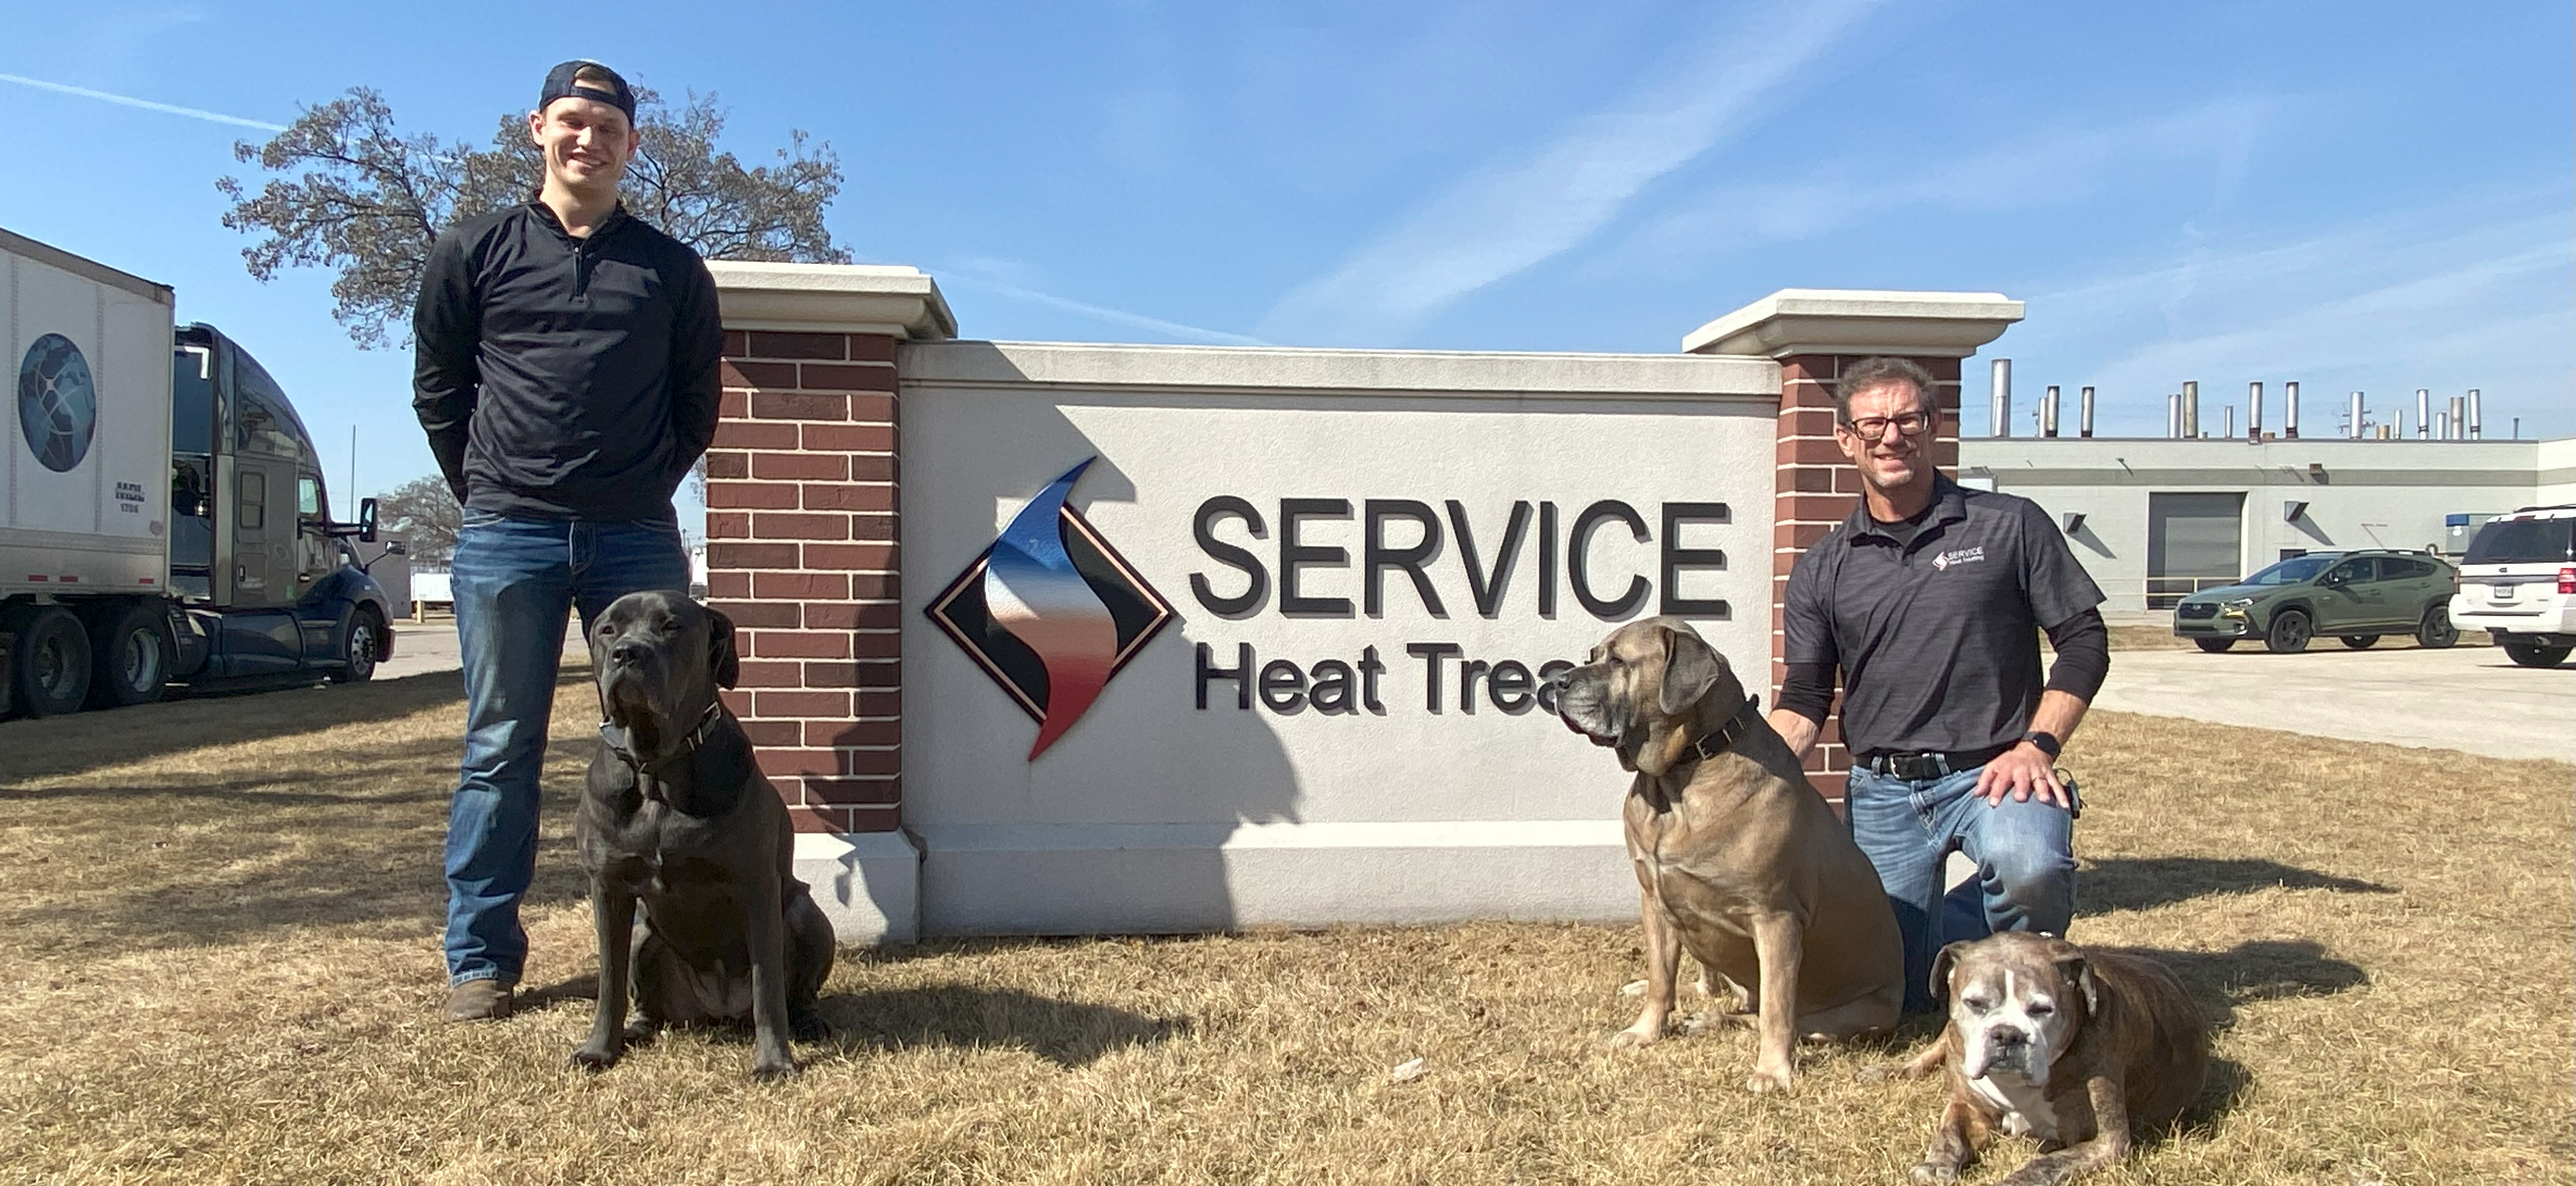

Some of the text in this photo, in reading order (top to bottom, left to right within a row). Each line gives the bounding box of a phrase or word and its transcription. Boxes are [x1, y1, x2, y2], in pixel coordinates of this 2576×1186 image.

[1189, 495, 1732, 622] SERVICE
[1947, 546, 1983, 560] SERVICE
[1195, 642, 1386, 716] Heat
